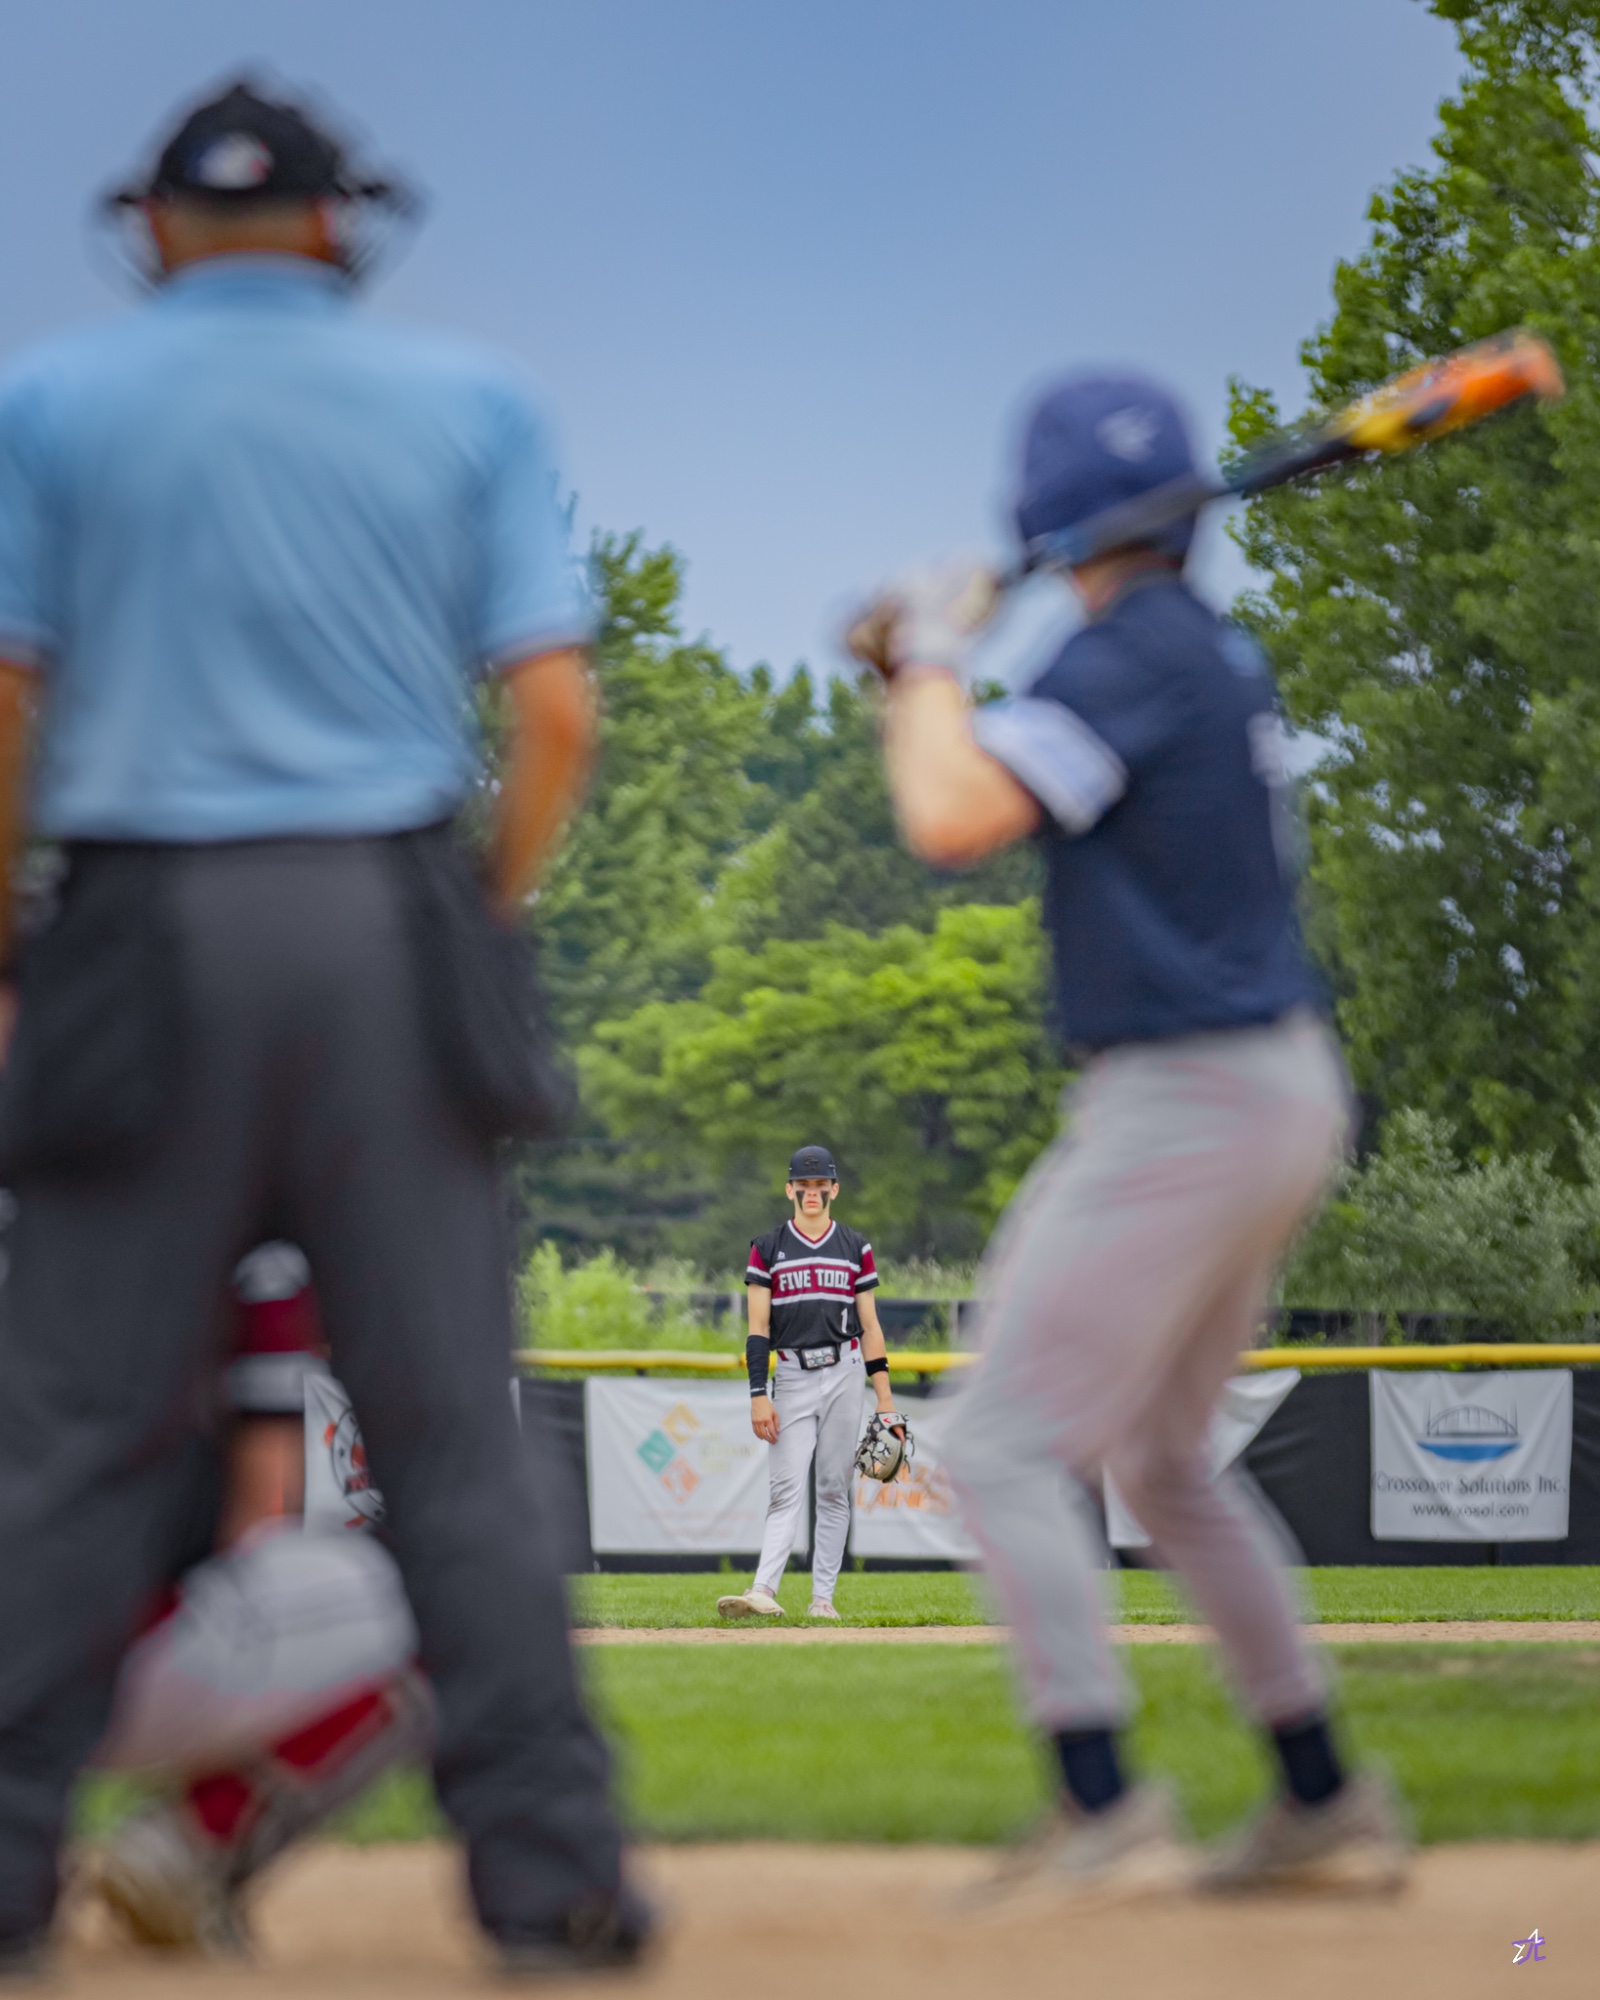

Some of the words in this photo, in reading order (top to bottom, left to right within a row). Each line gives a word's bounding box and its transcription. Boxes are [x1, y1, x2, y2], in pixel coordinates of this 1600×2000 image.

[778, 1269, 812, 1292] FIVE
[814, 1268, 851, 1290] TOOL
[841, 1308, 848, 1334] 1
[1372, 1472, 1452, 1494] Crossover
[1458, 1474, 1531, 1495] Solutions
[1538, 1473, 1566, 1494] Inc.
